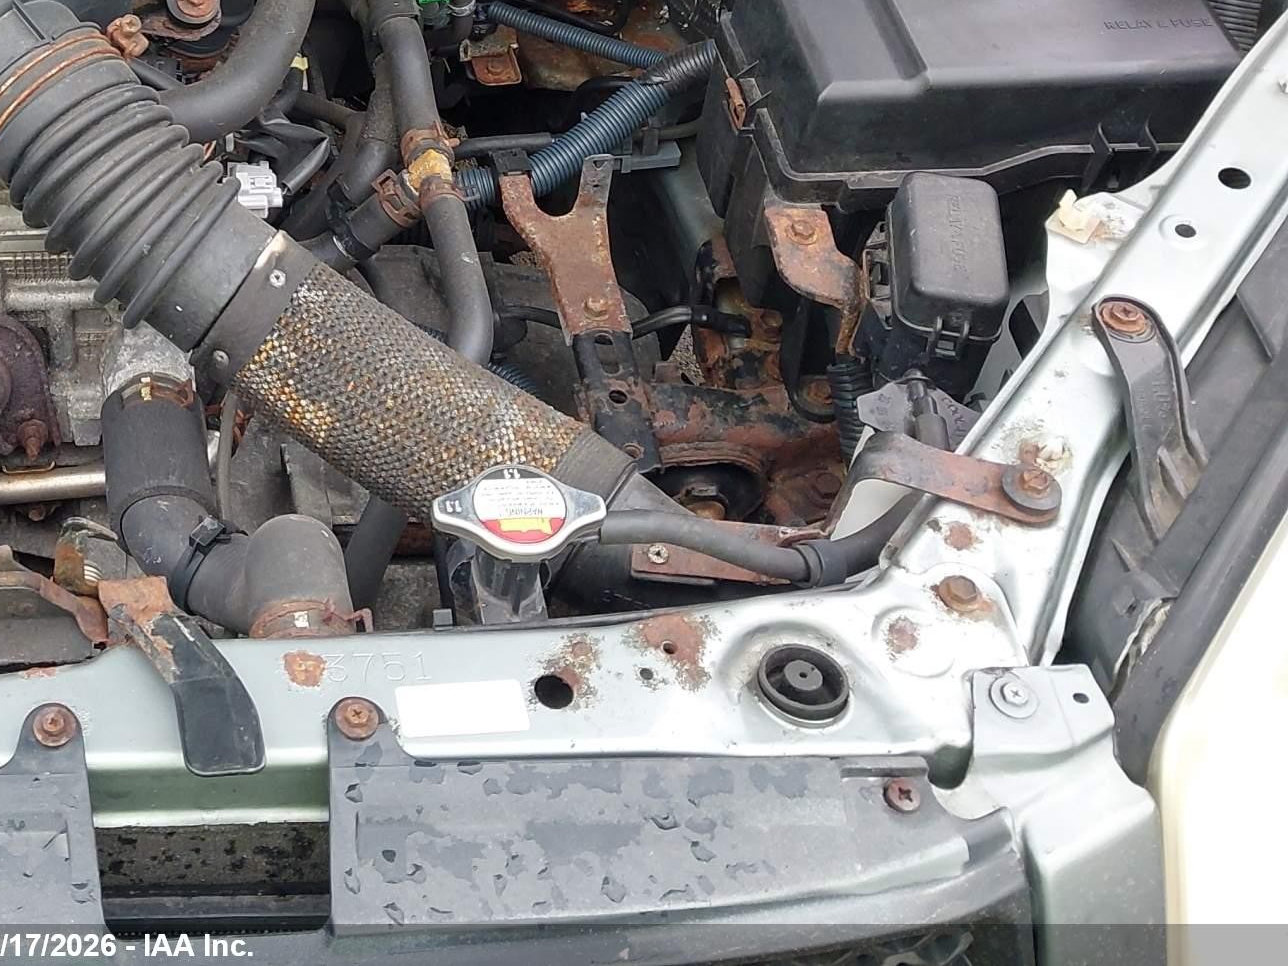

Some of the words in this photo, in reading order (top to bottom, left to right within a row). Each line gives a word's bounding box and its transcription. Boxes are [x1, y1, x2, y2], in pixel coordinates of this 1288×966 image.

[1103, 18, 1153, 30] RELAY
[1169, 17, 1214, 28] FUSE
[503, 468, 520, 479] 1.1
[445, 500, 462, 513] 1.1
